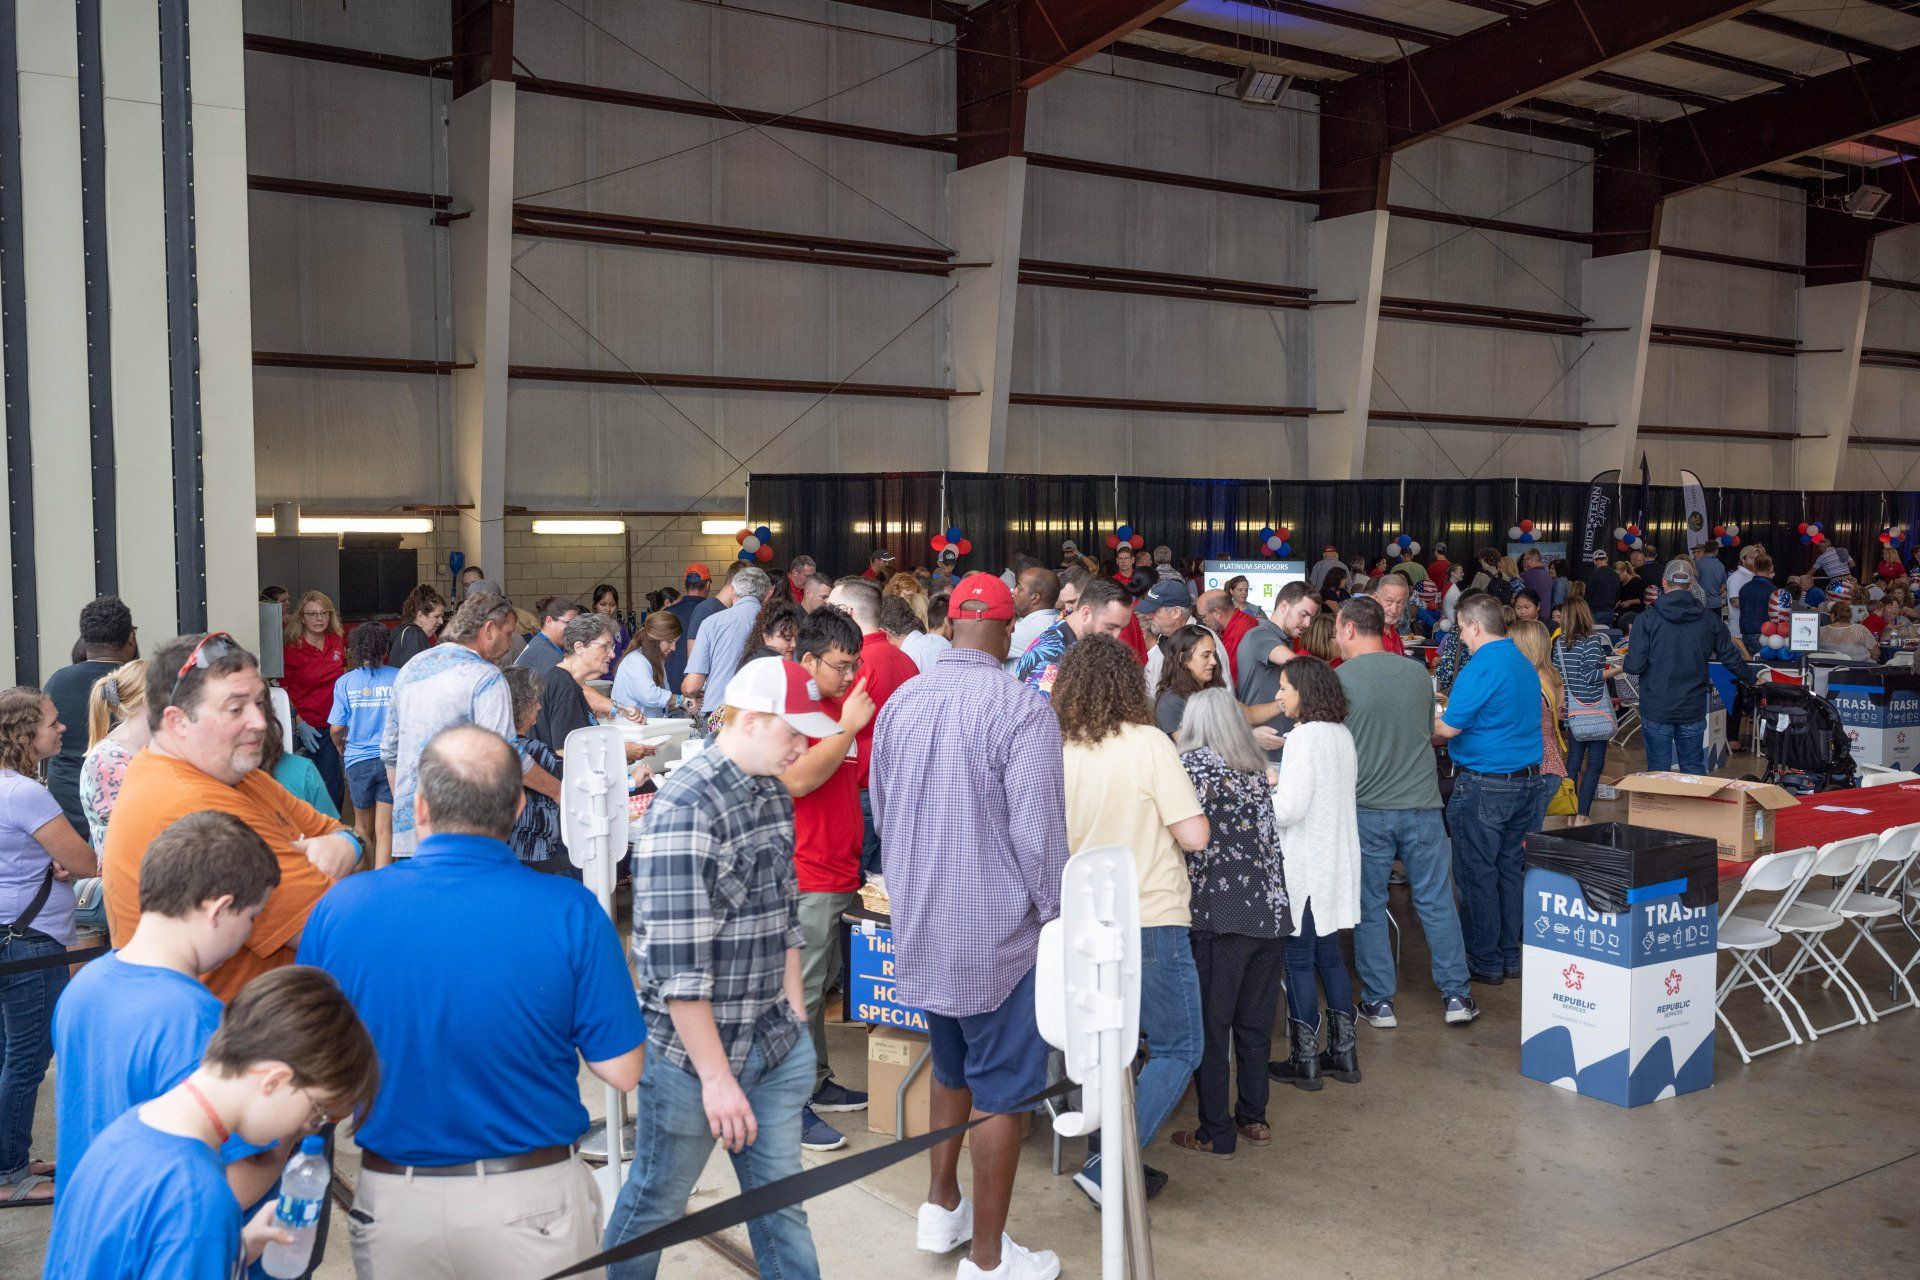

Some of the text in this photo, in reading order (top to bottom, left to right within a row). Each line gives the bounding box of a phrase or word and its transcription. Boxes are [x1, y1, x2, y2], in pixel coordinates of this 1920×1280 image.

[1584, 530, 1594, 551] MID
[1589, 486, 1602, 517] TENN
[1219, 563, 1289, 571] PLATINUM SPONSORS
[1835, 698, 1876, 711] TRASH
[1889, 699, 1919, 711] TRASH
[1538, 891, 1617, 927] TRASH
[1553, 993, 1596, 1010] REPUBLIC
[1562, 1003, 1587, 1014] SERVICES
[1656, 999, 1691, 1014] REPUBLIC
